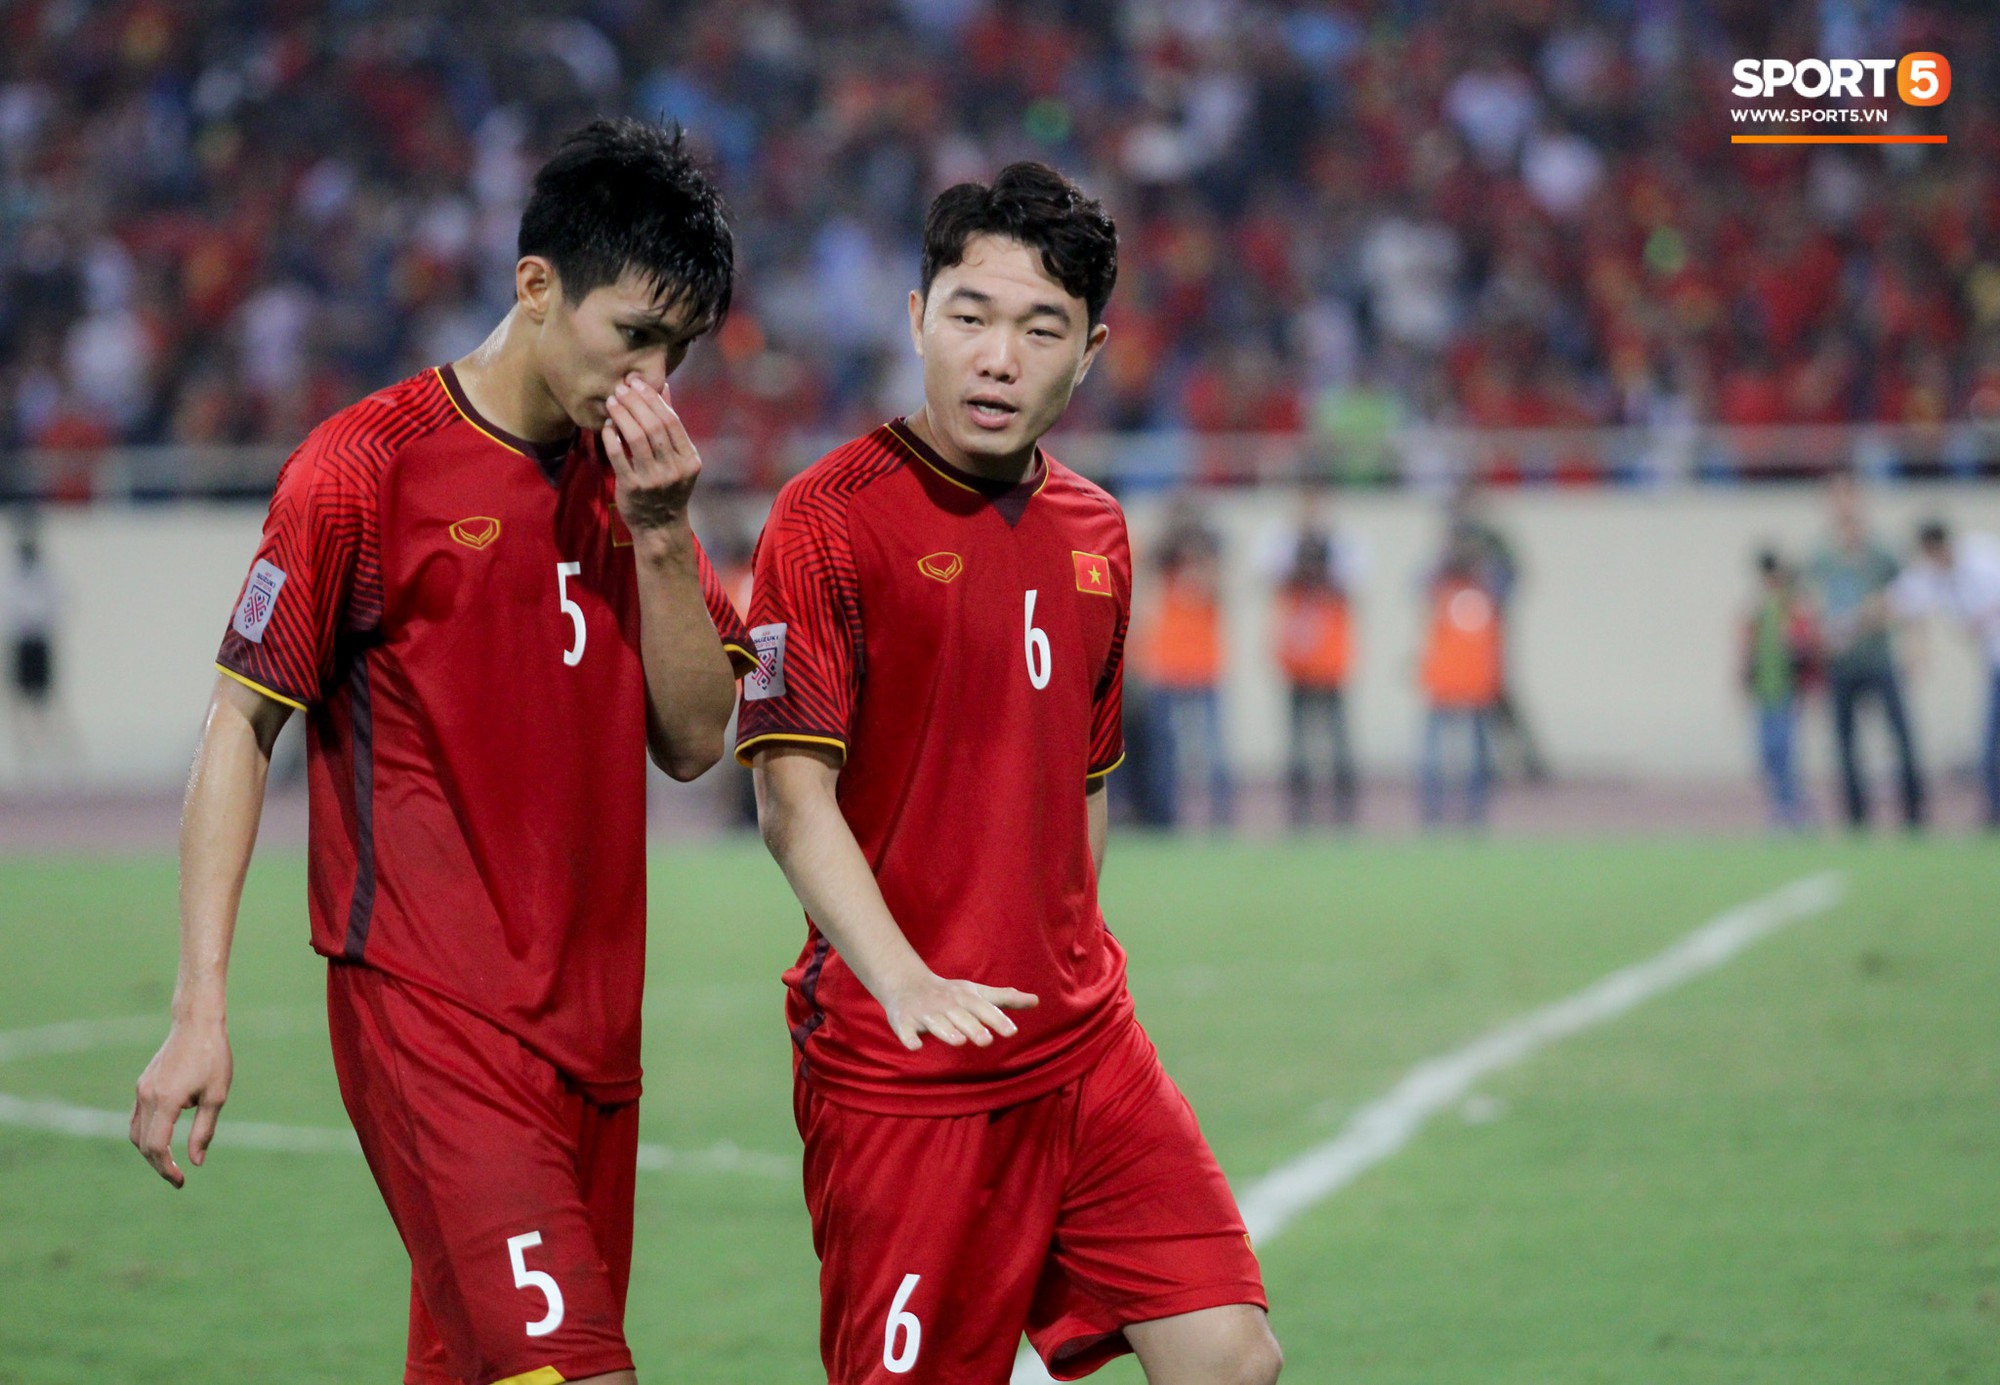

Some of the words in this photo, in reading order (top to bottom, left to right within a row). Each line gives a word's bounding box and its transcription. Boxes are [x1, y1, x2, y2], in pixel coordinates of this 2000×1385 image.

[556, 561, 587, 667] 5
[1024, 589, 1052, 690] 6
[506, 1230, 565, 1337] 5
[882, 1273, 922, 1374] 6
